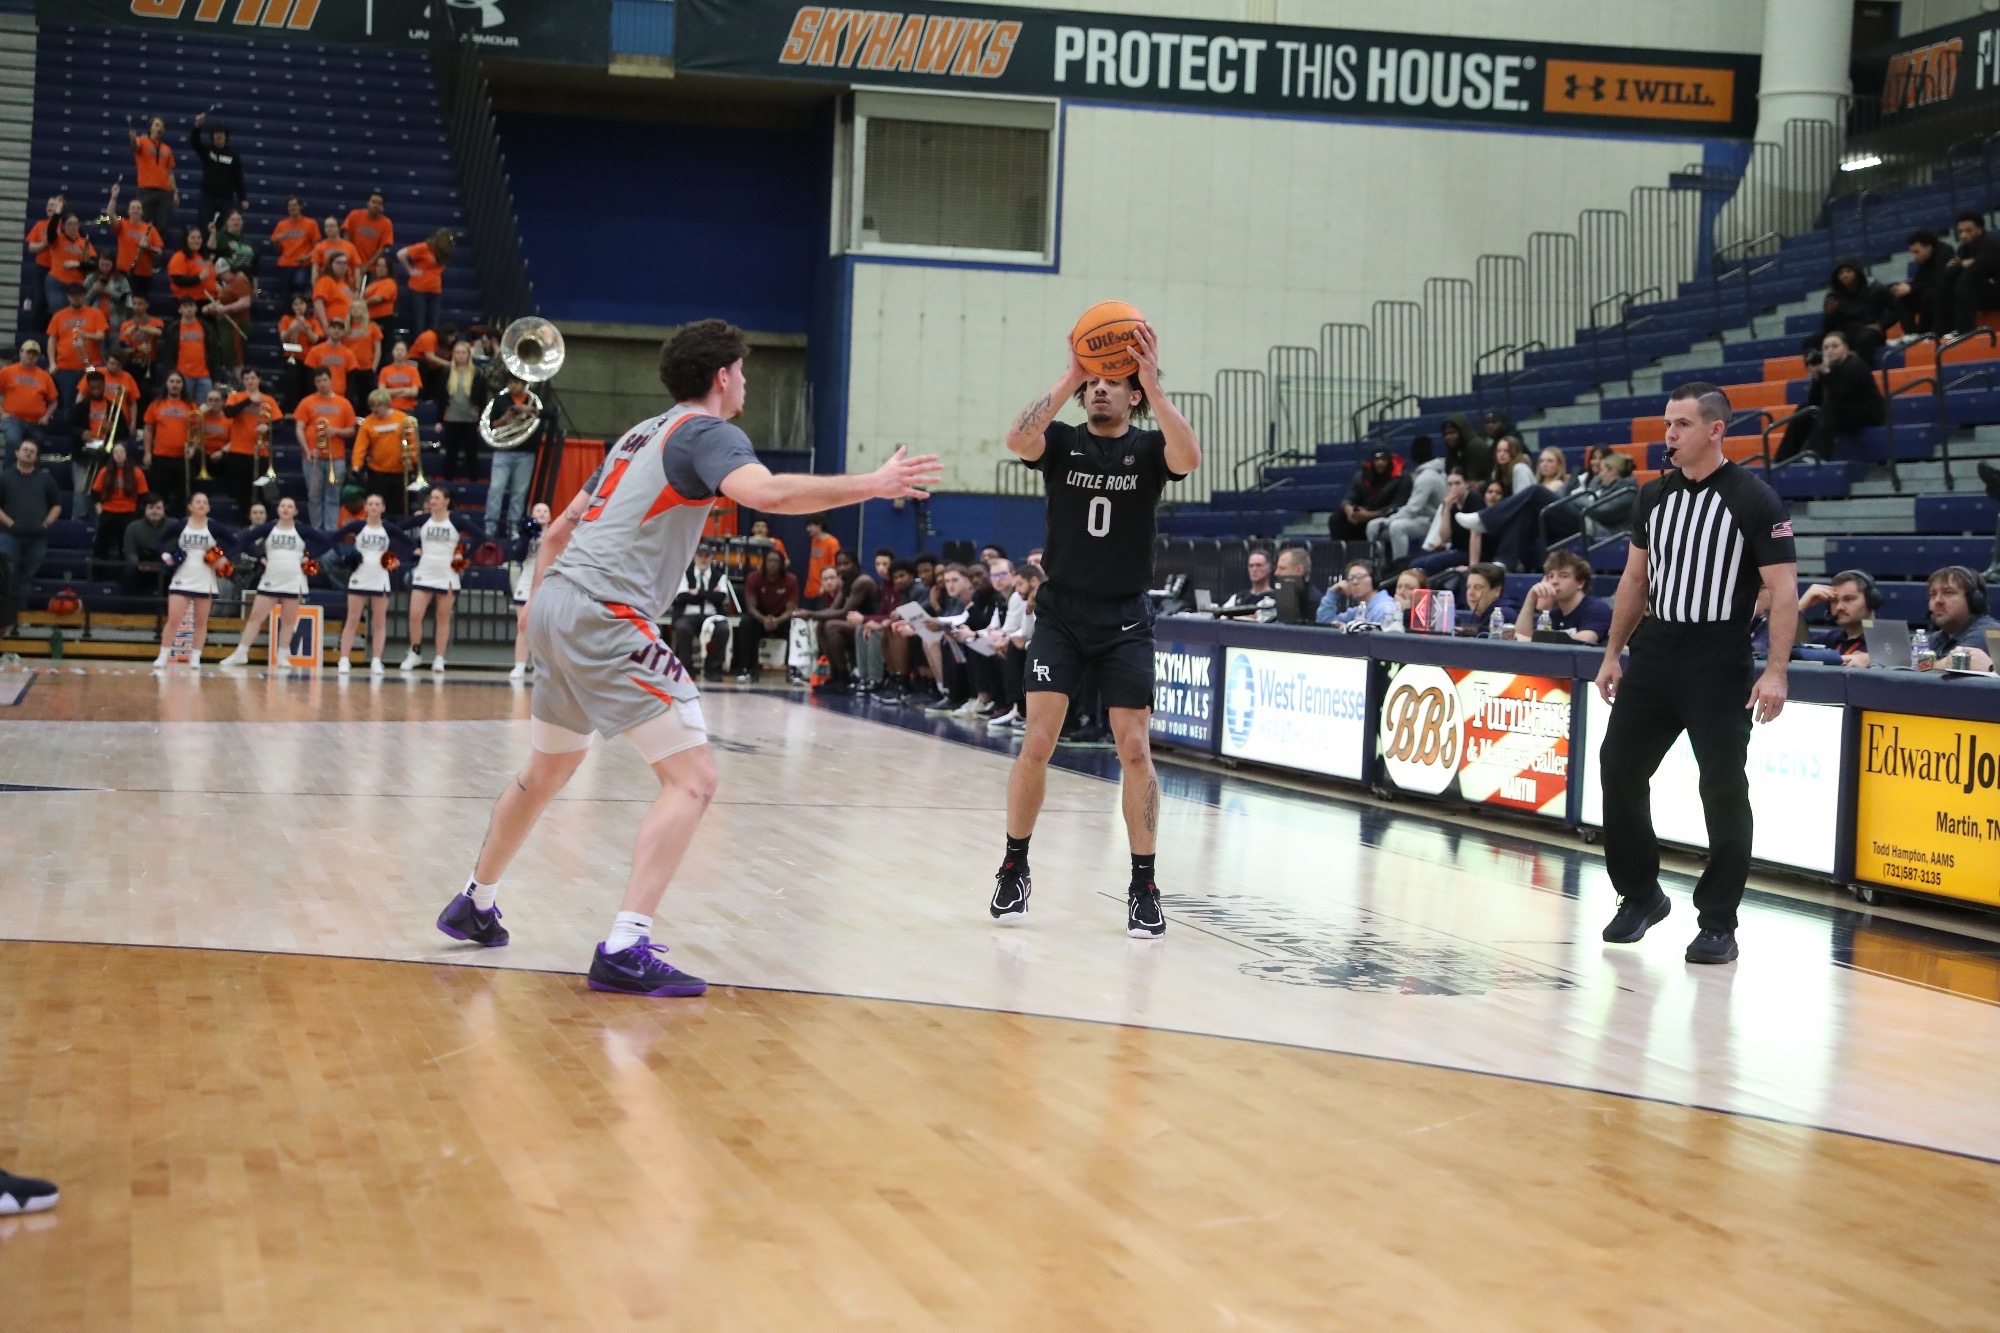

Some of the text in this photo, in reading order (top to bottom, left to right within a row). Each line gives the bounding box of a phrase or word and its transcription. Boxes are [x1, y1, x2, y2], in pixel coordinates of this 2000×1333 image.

[779, 6, 1022, 78] SKYHAWKS
[1054, 25, 1267, 94] PROTECT
[1276, 40, 1357, 101] THIS
[1616, 78, 1628, 101] I
[1066, 470, 1138, 490] LITTLE ROCK
[1087, 496, 1112, 537] 0
[183, 533, 209, 545] UTM
[271, 534, 296, 545] UTM
[362, 534, 387, 545] UTM
[628, 642, 683, 683] UTM
[1154, 651, 1211, 687] SKYHAWK
[1259, 668, 1366, 721] West Tennesse
[1472, 682, 1571, 740] Furniture
[1168, 721, 1187, 737] YOUR
[1466, 735, 1478, 763] &
[1531, 746, 1568, 777] Galler
[1866, 723, 2000, 794] Edward Jo
[1936, 811, 1982, 842] Martin,
[1873, 841, 1955, 868] Todd Hampton, AAMS
[1883, 863, 1941, 885] (731)587-3135
